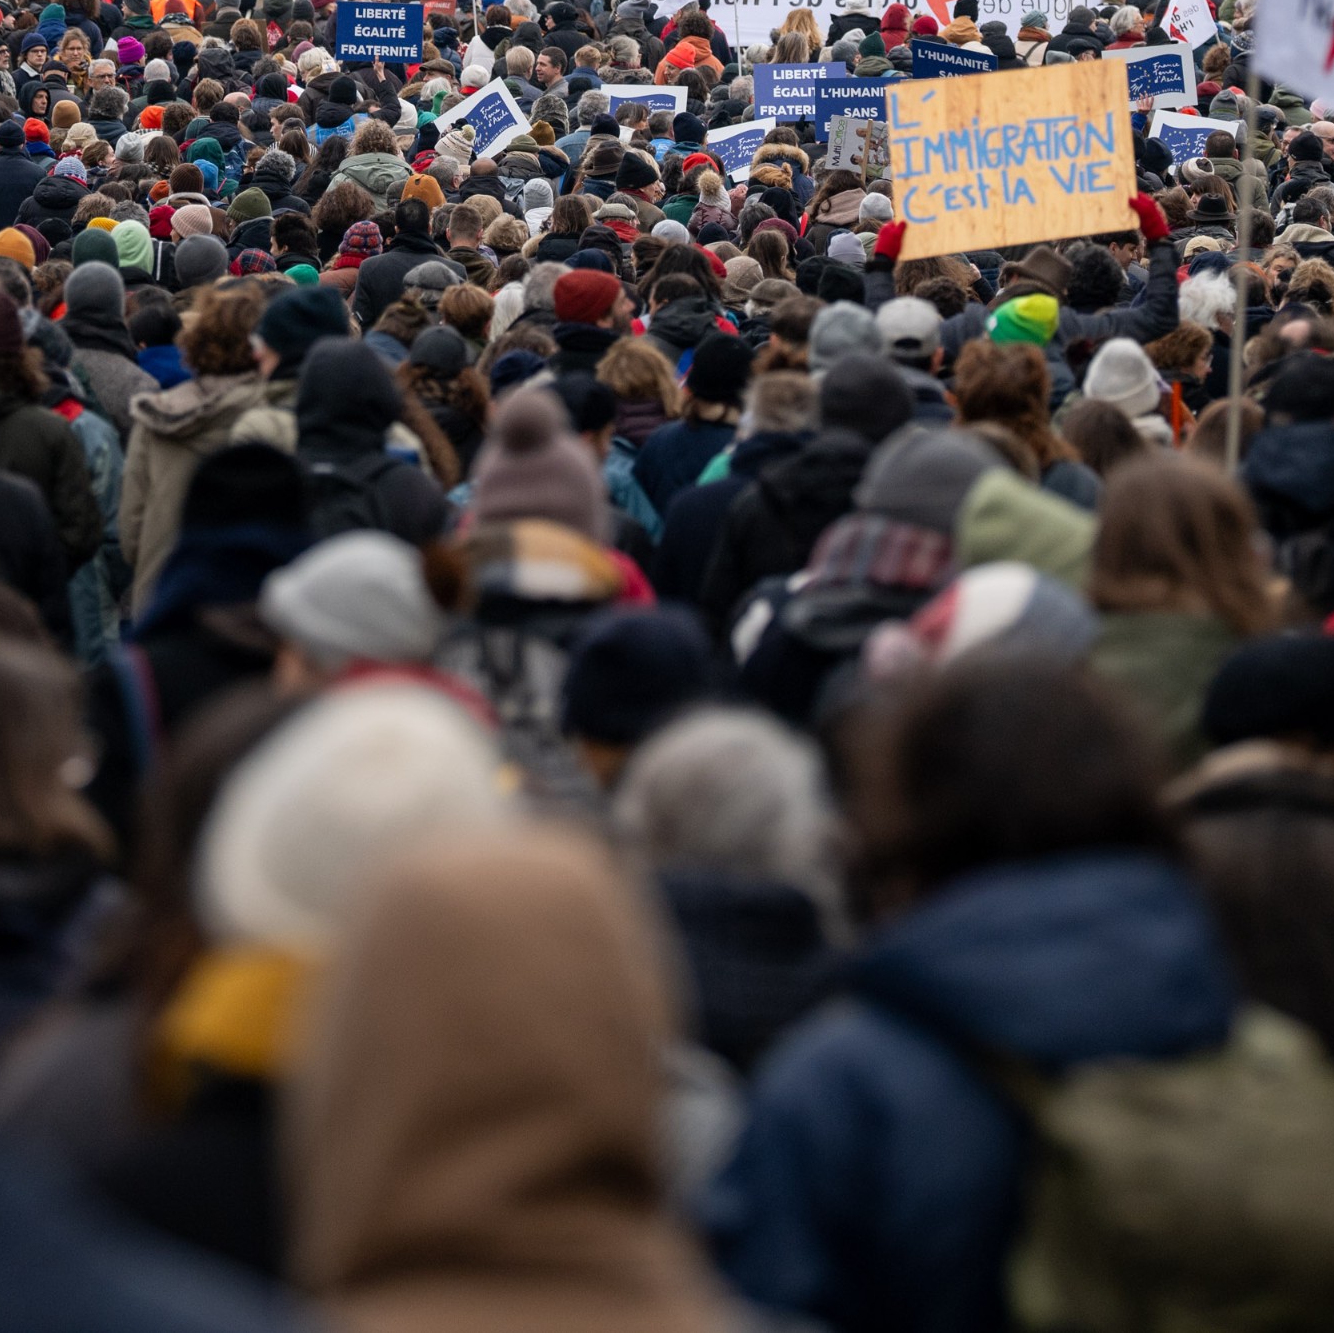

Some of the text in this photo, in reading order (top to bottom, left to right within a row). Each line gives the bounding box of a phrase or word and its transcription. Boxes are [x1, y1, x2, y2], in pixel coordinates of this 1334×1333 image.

[355, 7, 406, 20] LIBERTÉ
[354, 25, 406, 38] ÉGALITÉ
[340, 44, 418, 58] FRATERNITÉ
[1152, 61, 1180, 69] France
[773, 66, 827, 80] LIBERTÉ
[647, 99, 673, 108] France
[843, 107, 878, 118] SANS
